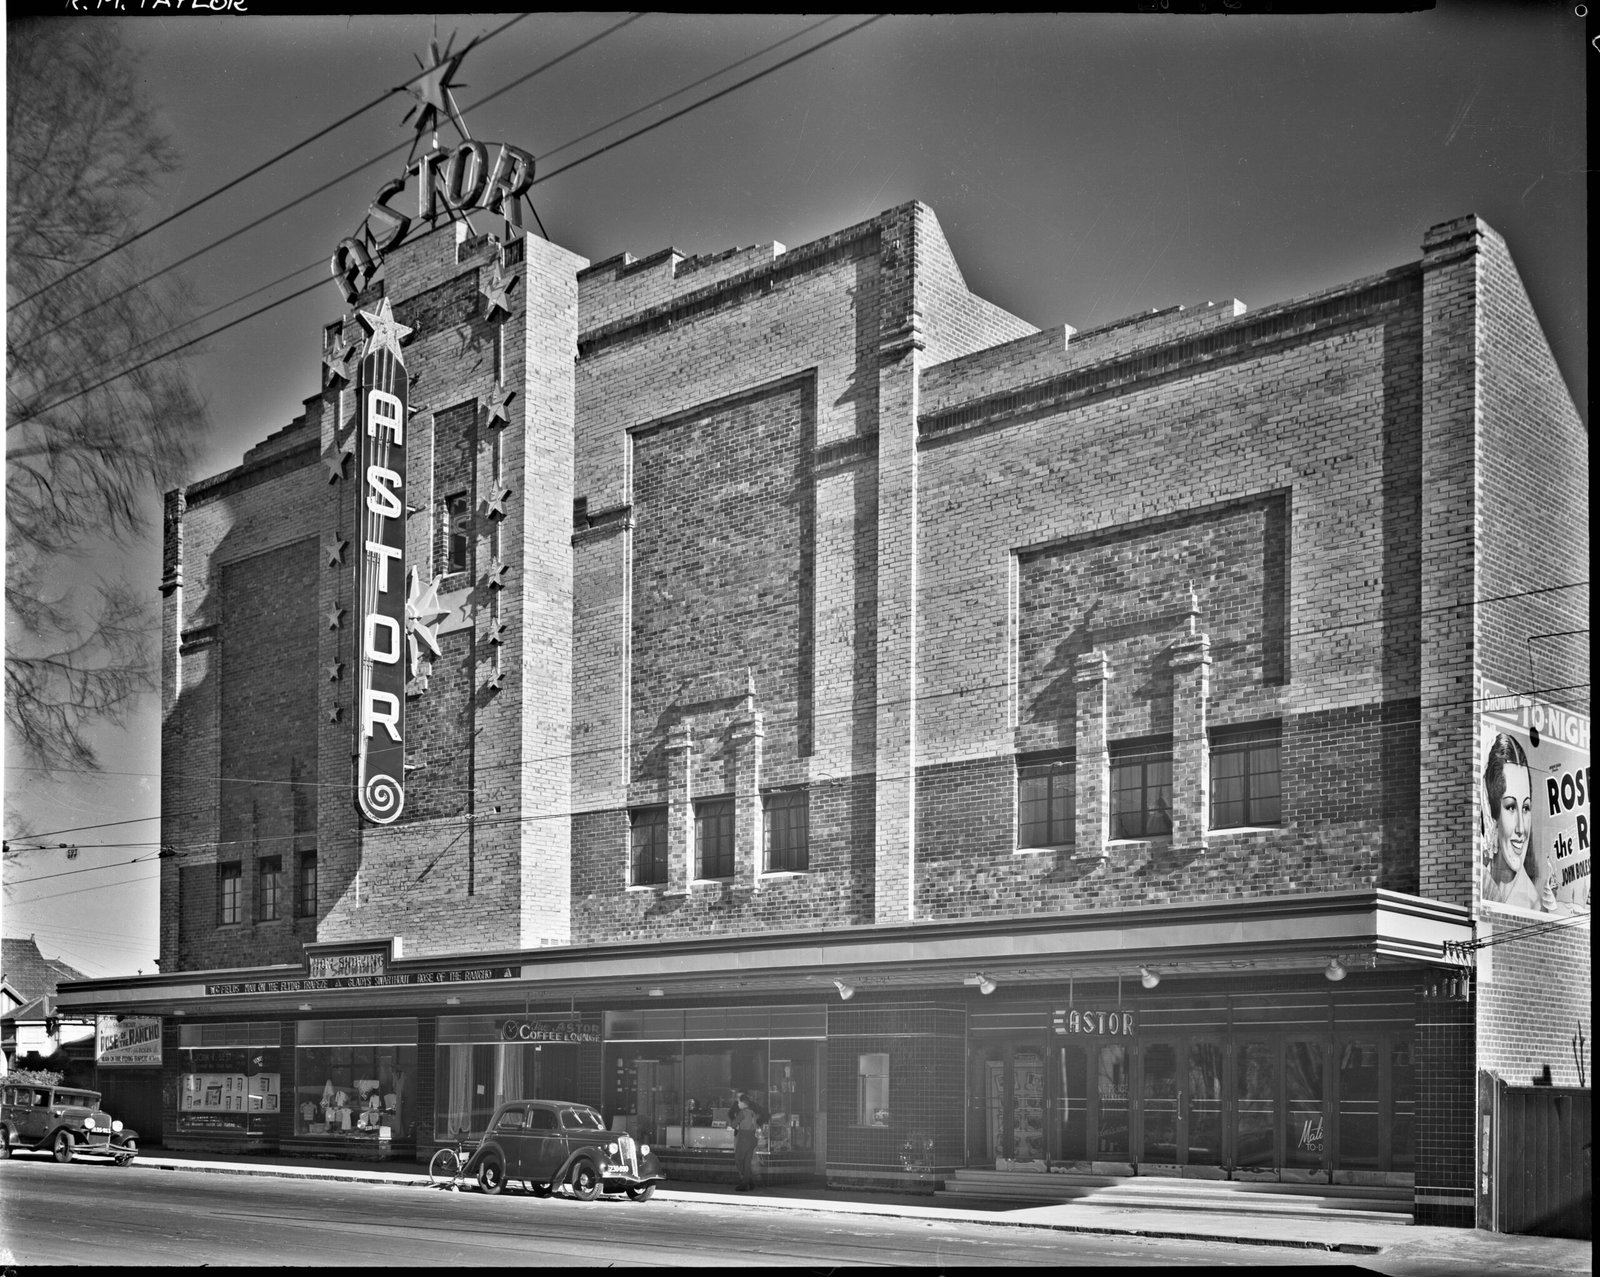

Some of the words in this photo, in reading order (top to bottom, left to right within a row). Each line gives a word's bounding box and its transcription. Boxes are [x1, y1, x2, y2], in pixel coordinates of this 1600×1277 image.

[331, 138, 536, 305] ASTOR
[365, 389, 402, 742] ASTOR
[1554, 833, 1573, 860] the
[1562, 865, 1575, 887] JOHN
[268, 981, 278, 991] THE
[347, 977, 372, 987] GLADYS
[374, 974, 410, 986] SWARTHOUT
[416, 973, 434, 983] ROSE
[436, 972, 445, 982] OF
[449, 971, 462, 981] THE
[464, 969, 492, 980] RANCHO
[519, 1024, 563, 1041] COFFEE
[1069, 1010, 1134, 1036] ASTOR
